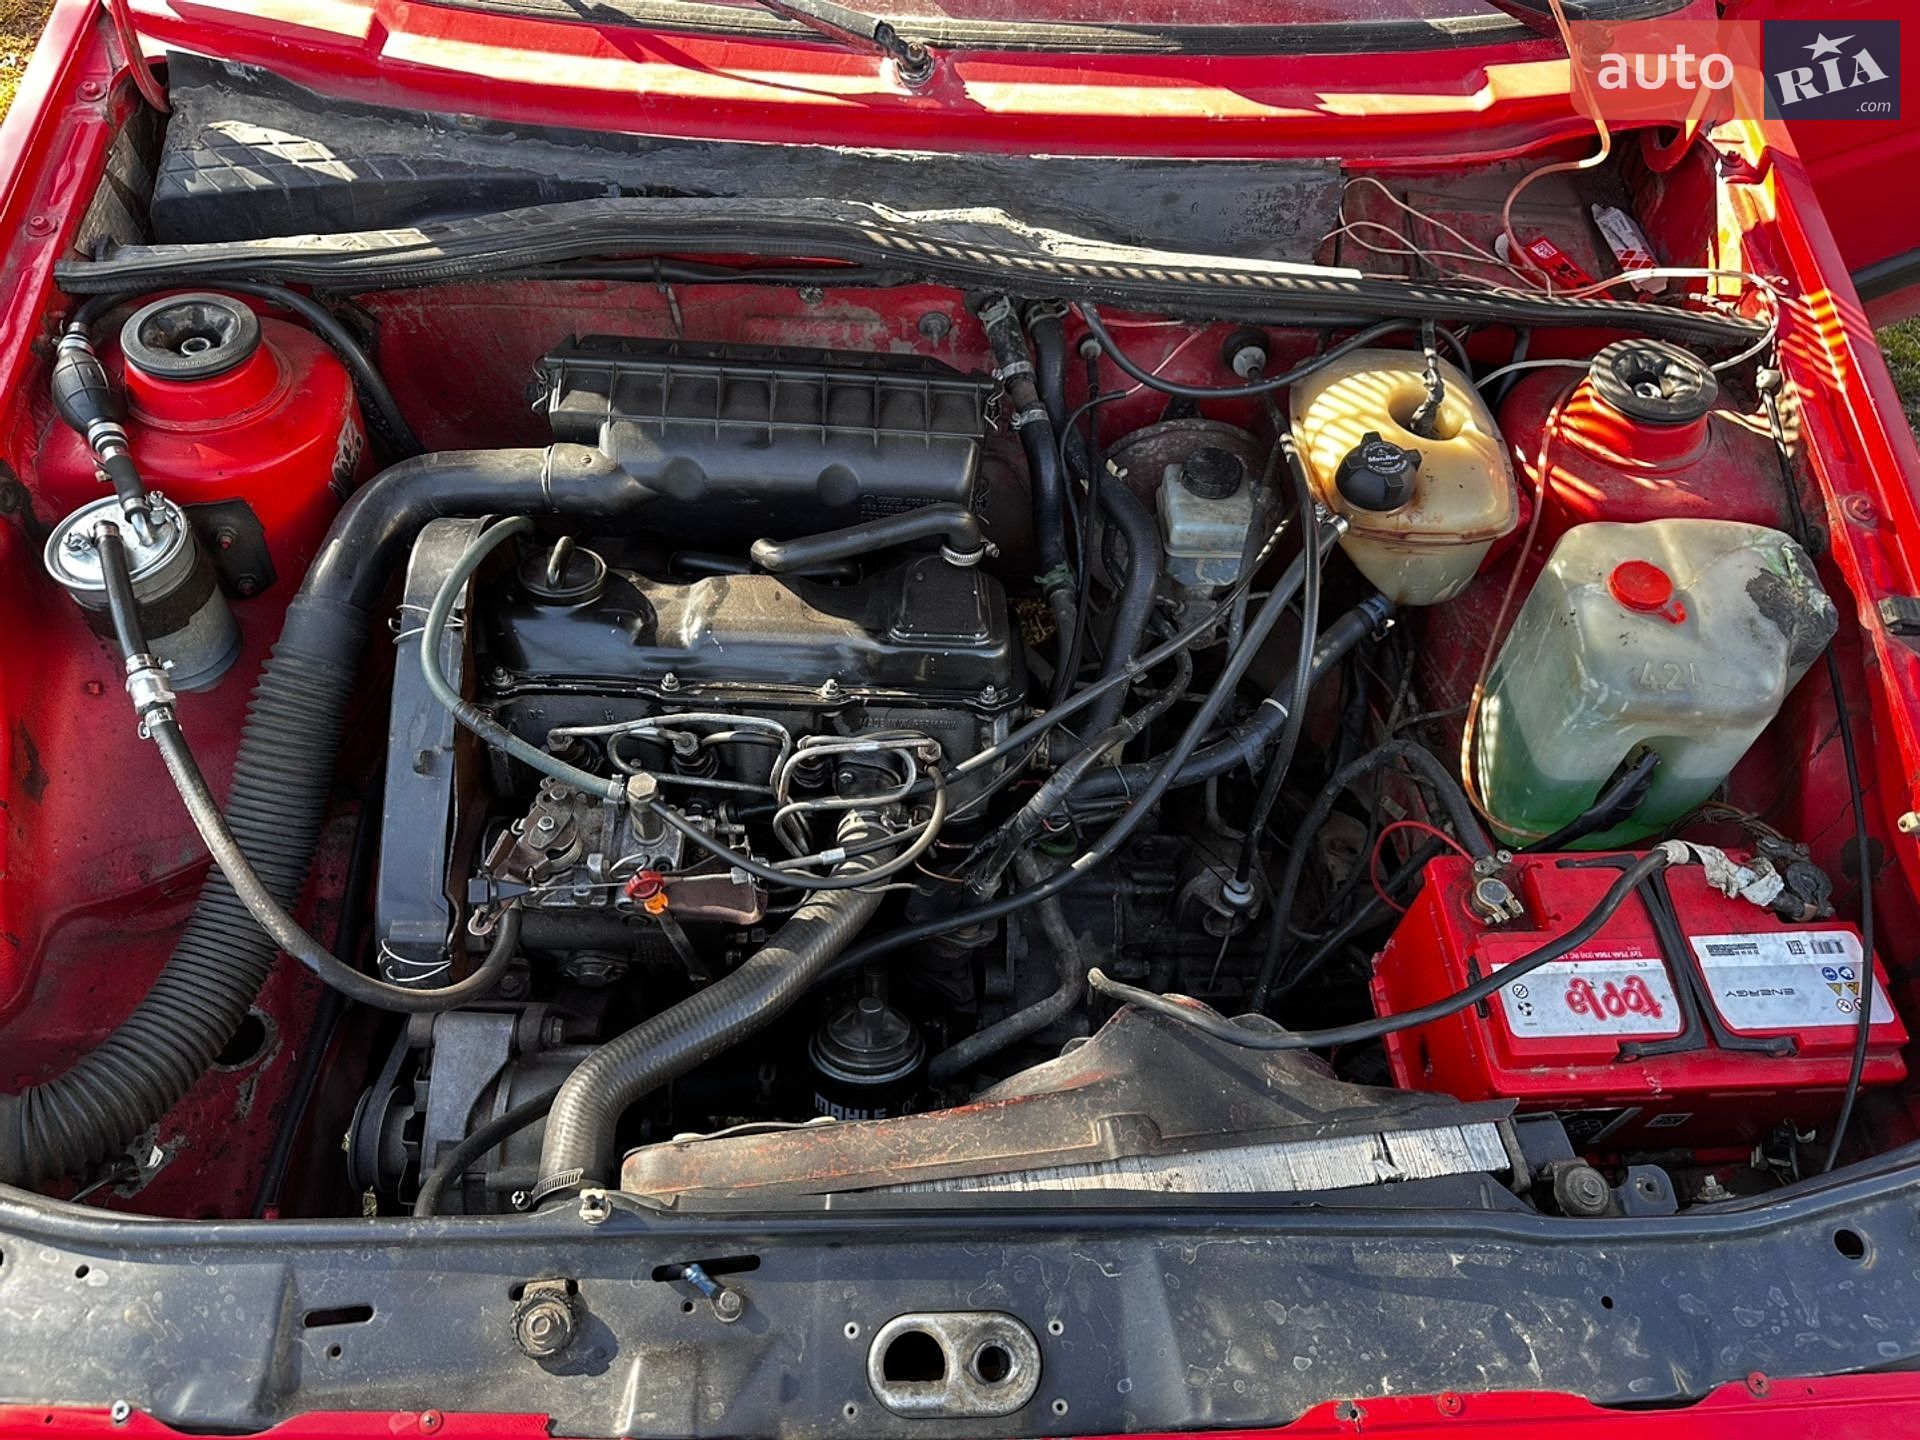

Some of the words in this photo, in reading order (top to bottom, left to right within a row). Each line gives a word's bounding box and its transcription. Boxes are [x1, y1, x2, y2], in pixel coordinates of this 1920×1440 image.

[1564, 974, 1663, 1021] topla
[1725, 987, 1796, 998] ENERGY
[815, 1092, 887, 1121] MAHLE
